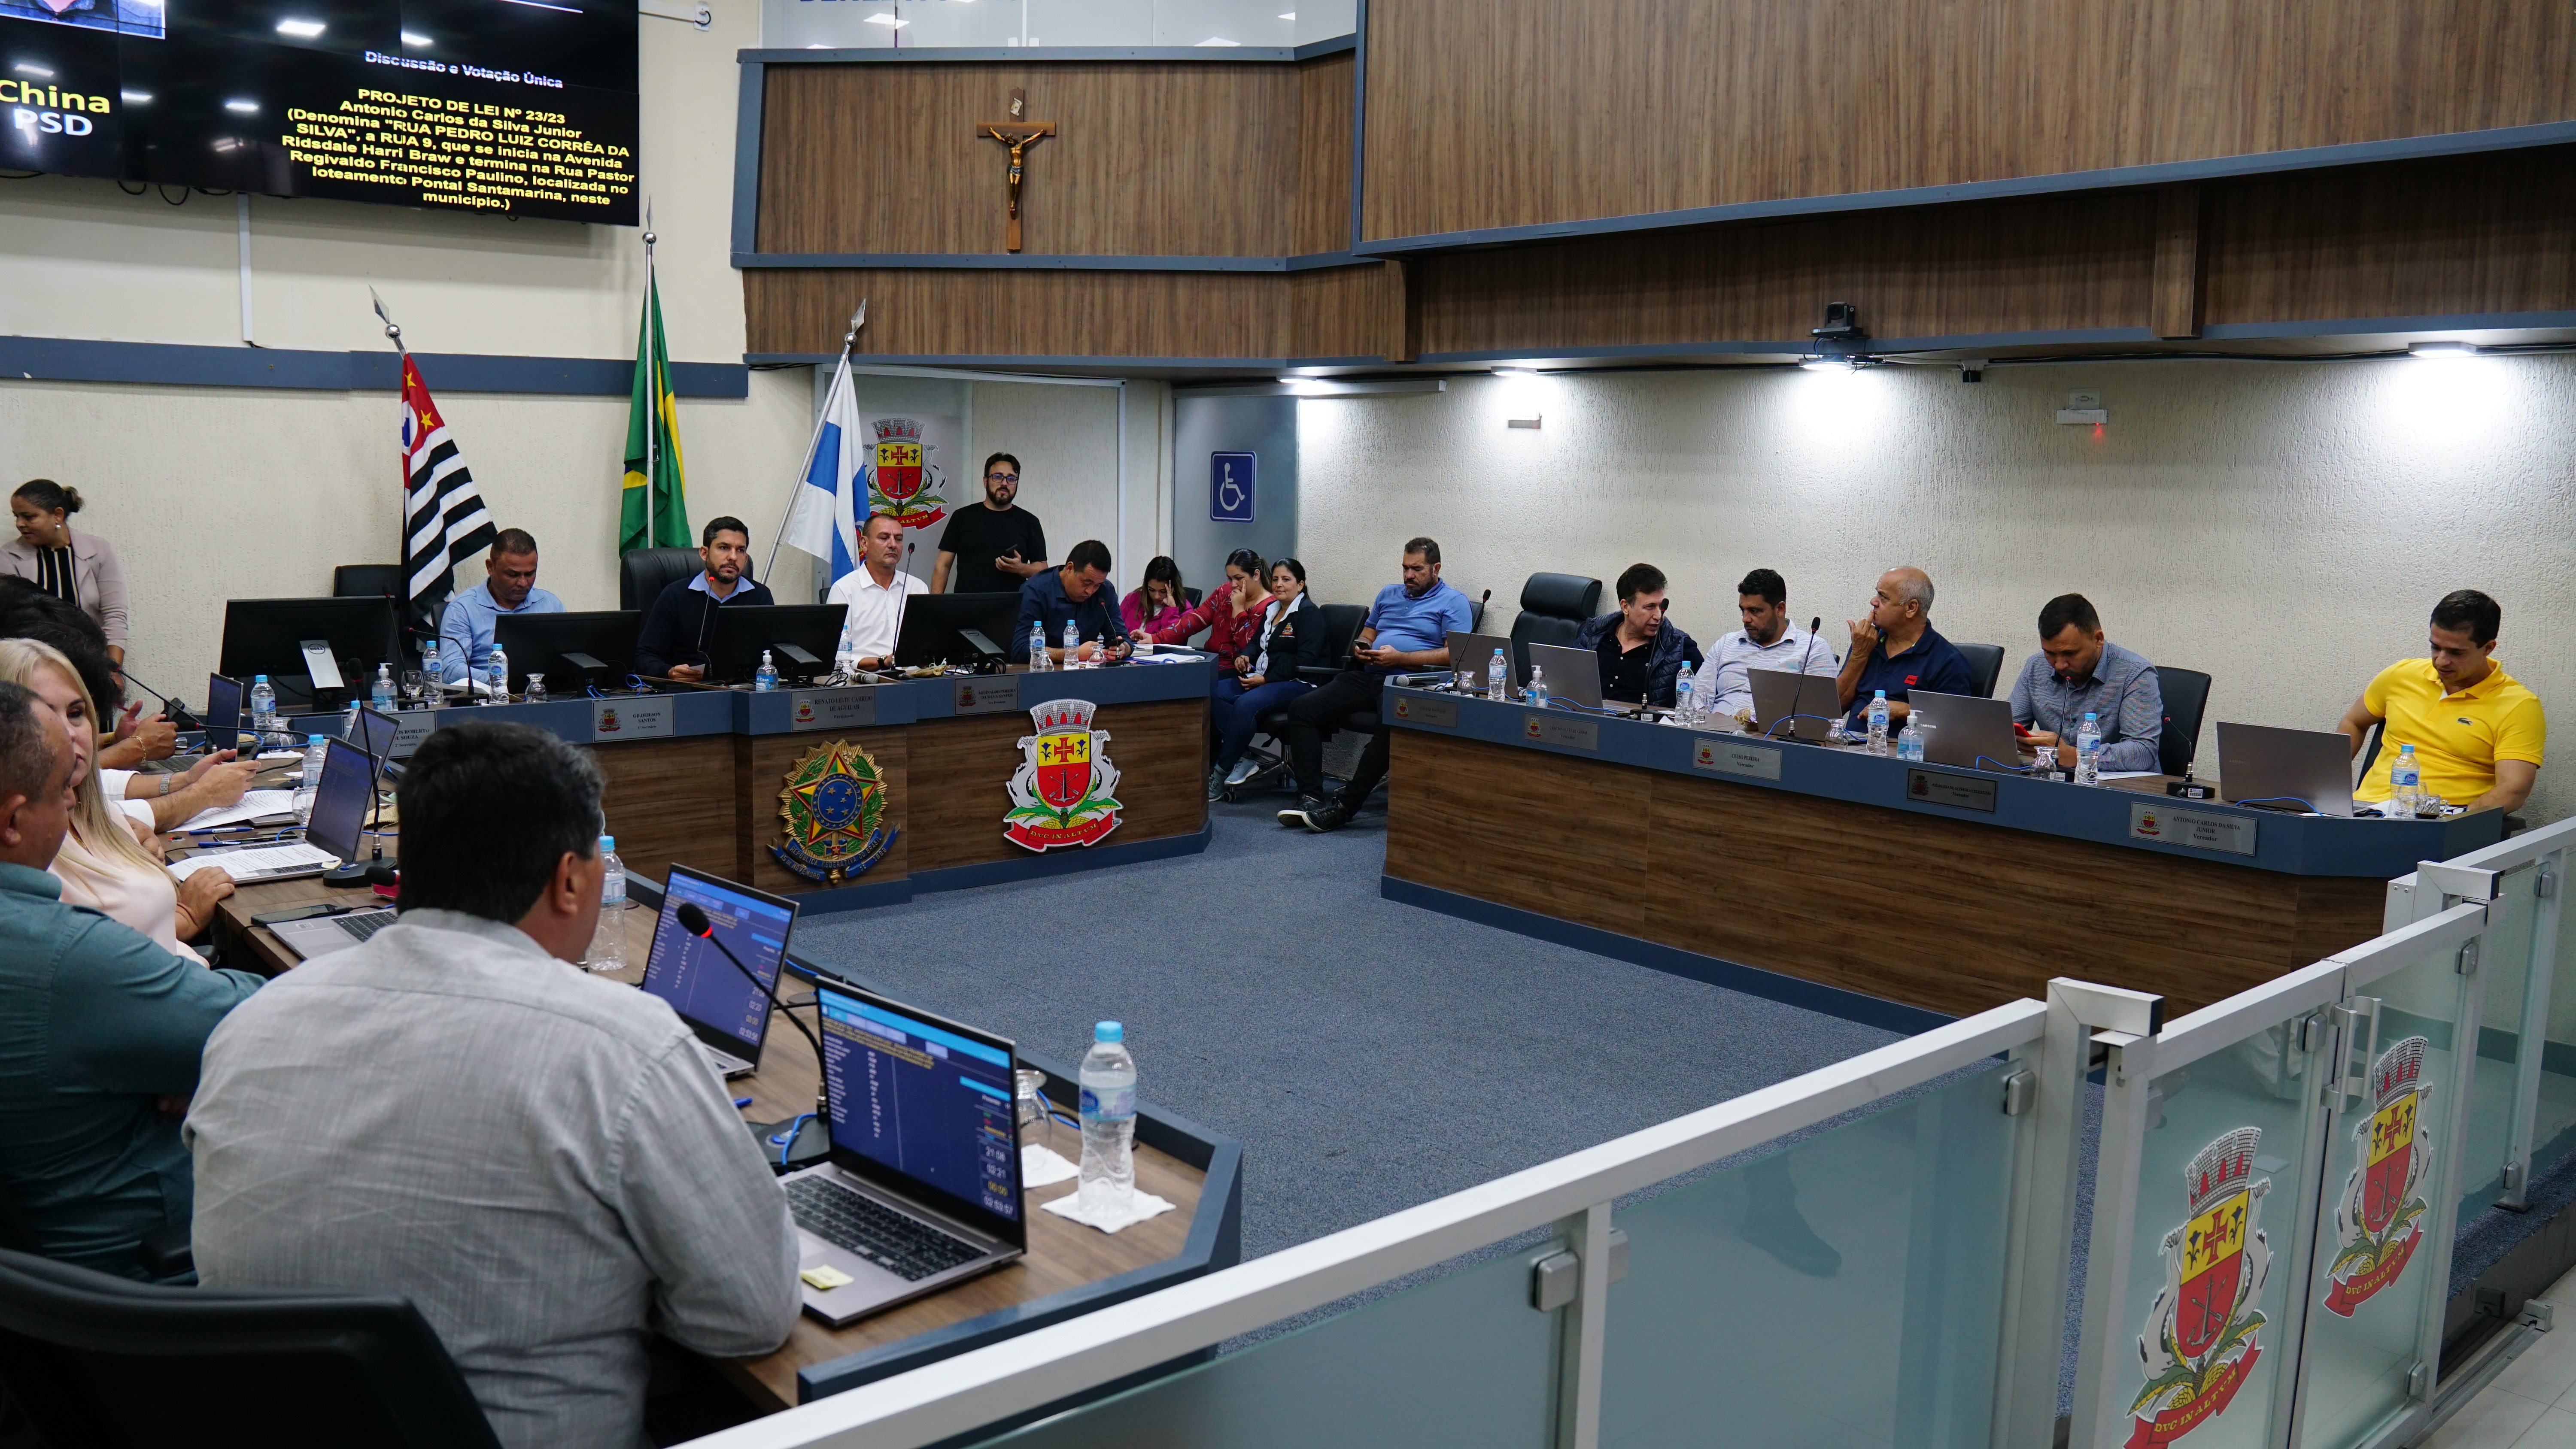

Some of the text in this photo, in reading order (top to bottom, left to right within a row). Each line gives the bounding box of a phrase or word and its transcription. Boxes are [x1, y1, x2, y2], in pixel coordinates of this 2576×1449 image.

[365, 51, 563, 88] Discussão e Votação Única
[0, 80, 110, 113] China
[358, 89, 565, 124] PROJETO DE LEI Nº 23/23
[14, 108, 92, 136] PSD
[288, 108, 629, 157] (Denomina "RUA PEDRO LUIZ CORRÊA DA
[340, 101, 582, 138] Antonio Carlos da Silva Junior
[282, 135, 635, 182] Ridsdale Harri Braw e termina na Rua Pastor
[297, 123, 622, 169] SILVA", a RUA 9, que se inicia na Avenida
[290, 150, 628, 194] Regivaldo Francisco Paulino, localizada no
[313, 166, 611, 205] loteamento Pontal Santamarina, neste
[423, 192, 510, 210] município.)
[1051, 831, 1063, 839] IN
[1062, 823, 1097, 838] ALTVM
[2193, 834, 2218, 842] Vereador
[791, 863, 820, 879] NOVEMBRO
[822, 857, 857, 868] FEDERATIVA
[865, 837, 882, 854] BRASIL
[2345, 1246, 2404, 1294] DVC IN ALTVM
[2154, 1368, 2236, 1432] DVC IN ALTVM
